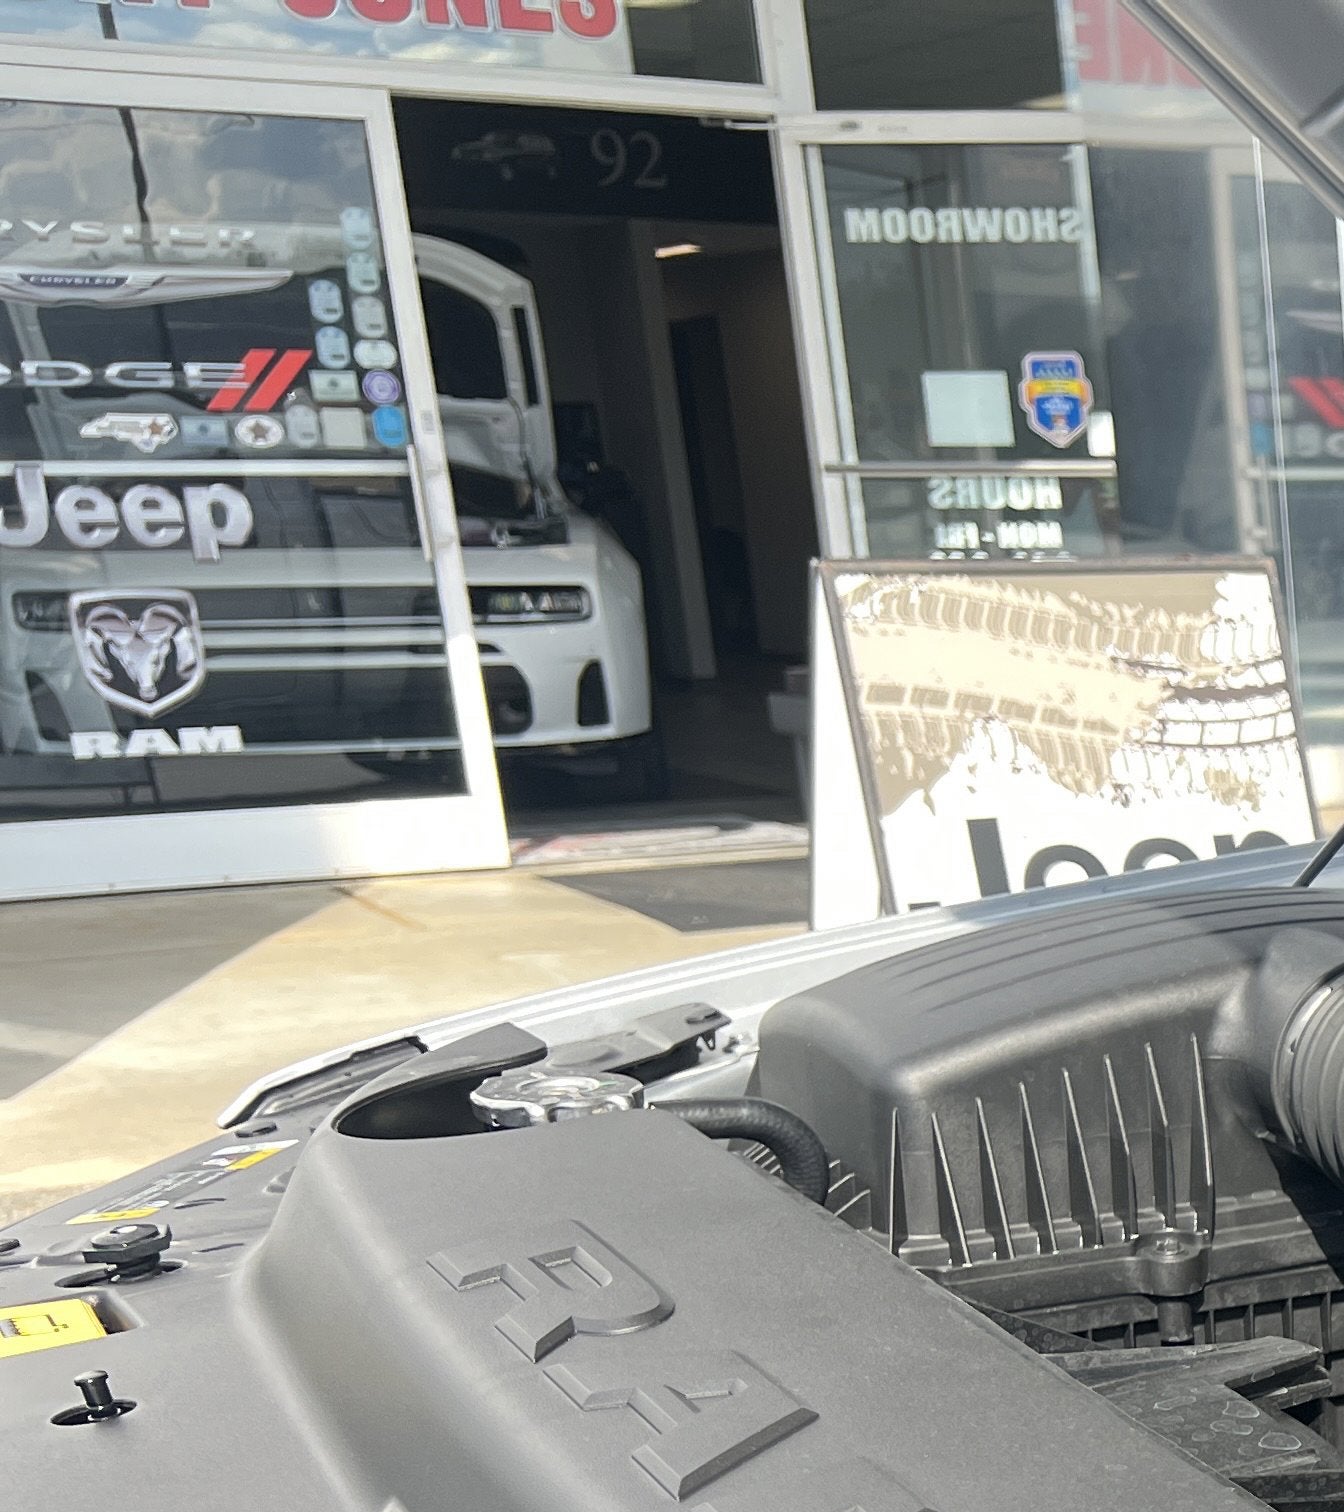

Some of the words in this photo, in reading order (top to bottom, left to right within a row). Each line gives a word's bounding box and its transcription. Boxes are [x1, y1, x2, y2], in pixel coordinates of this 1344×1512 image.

[590, 128, 668, 190] 92
[0, 360, 250, 388] DGE
[1, 463, 253, 563] Jeep
[71, 725, 243, 760] RAM
